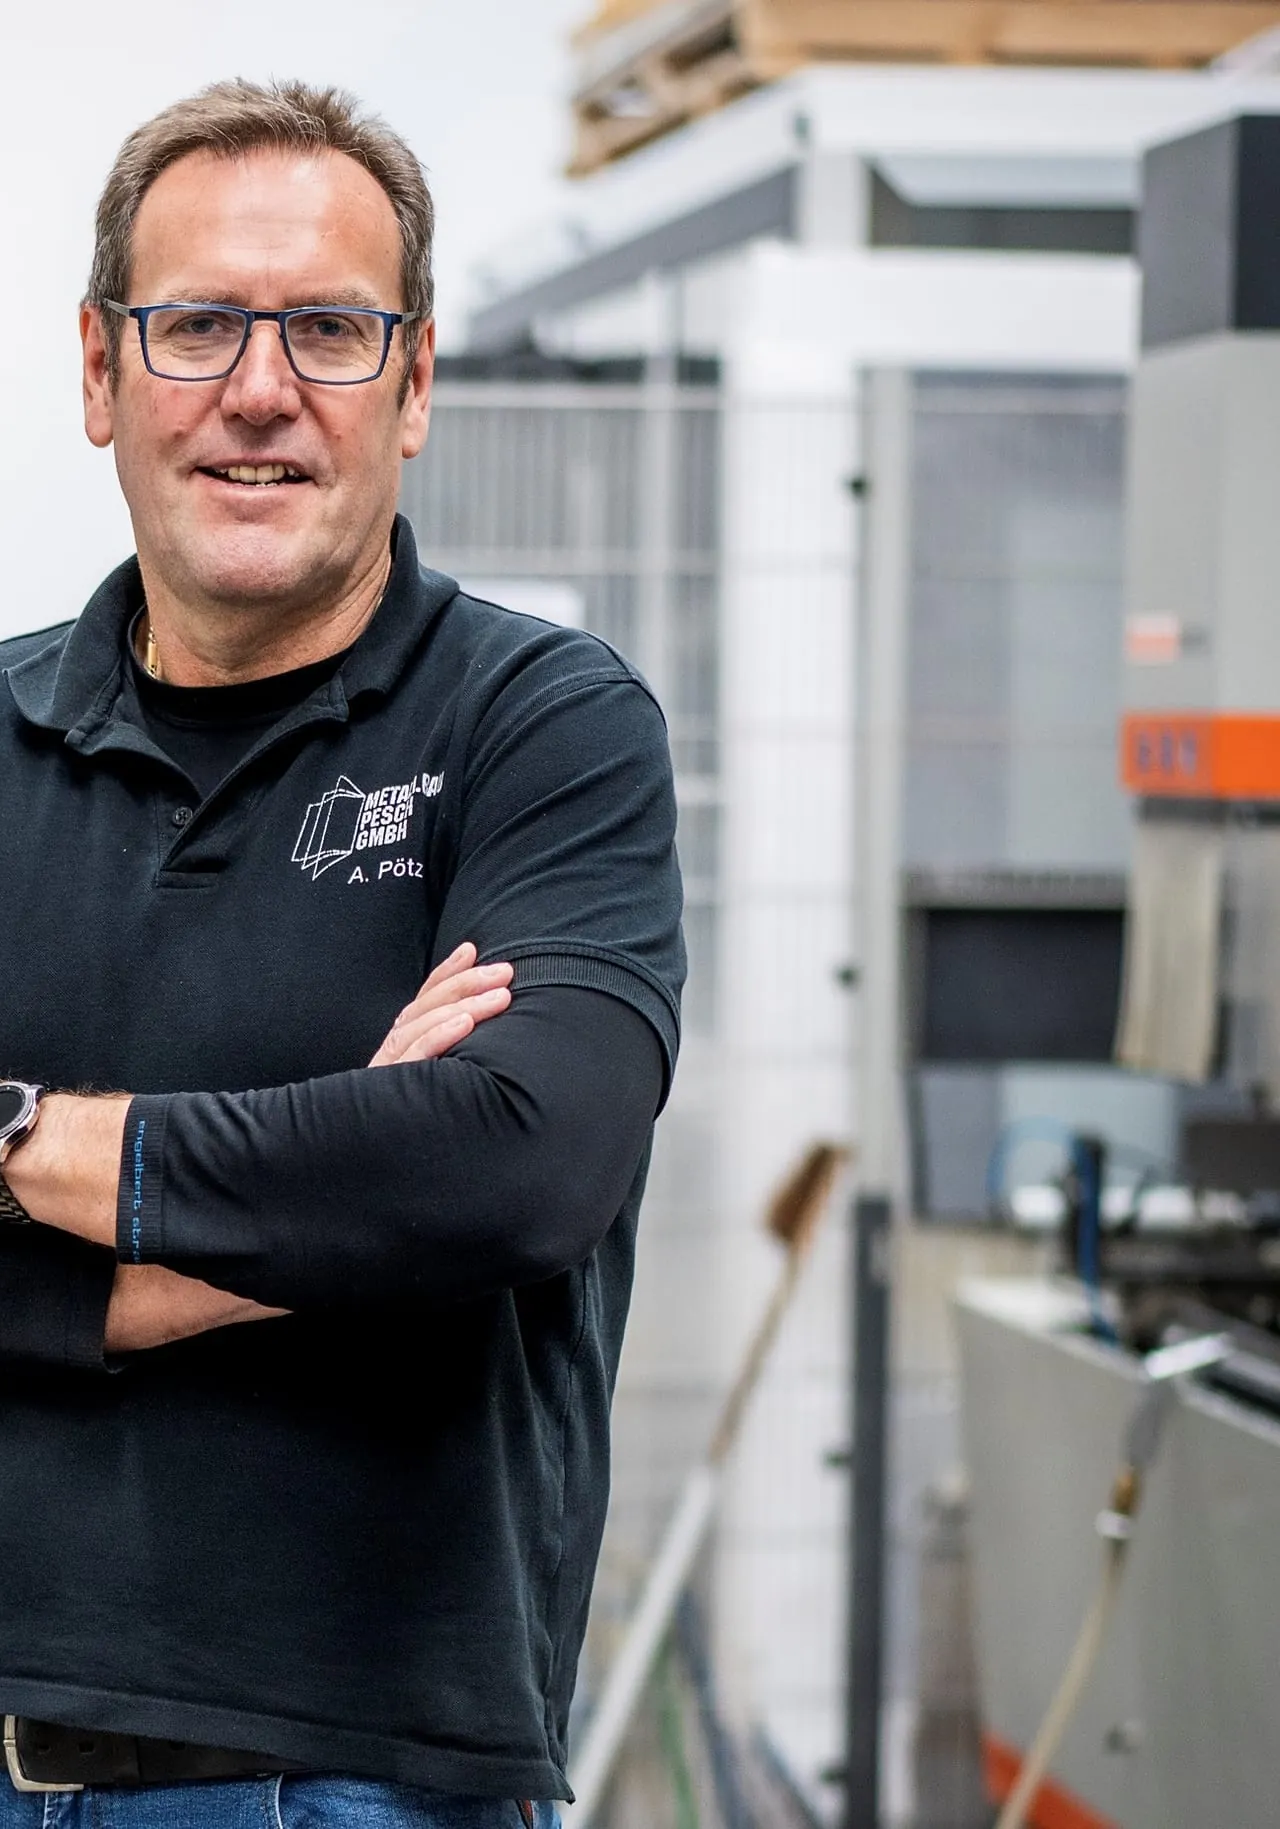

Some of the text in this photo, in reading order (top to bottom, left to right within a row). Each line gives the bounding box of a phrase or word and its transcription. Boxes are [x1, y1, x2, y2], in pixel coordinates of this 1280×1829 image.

[360, 796, 414, 831] PESCH
[355, 819, 408, 850] GMBH
[347, 857, 424, 885] A. Pötz
[133, 1120, 146, 1210] engelbert
